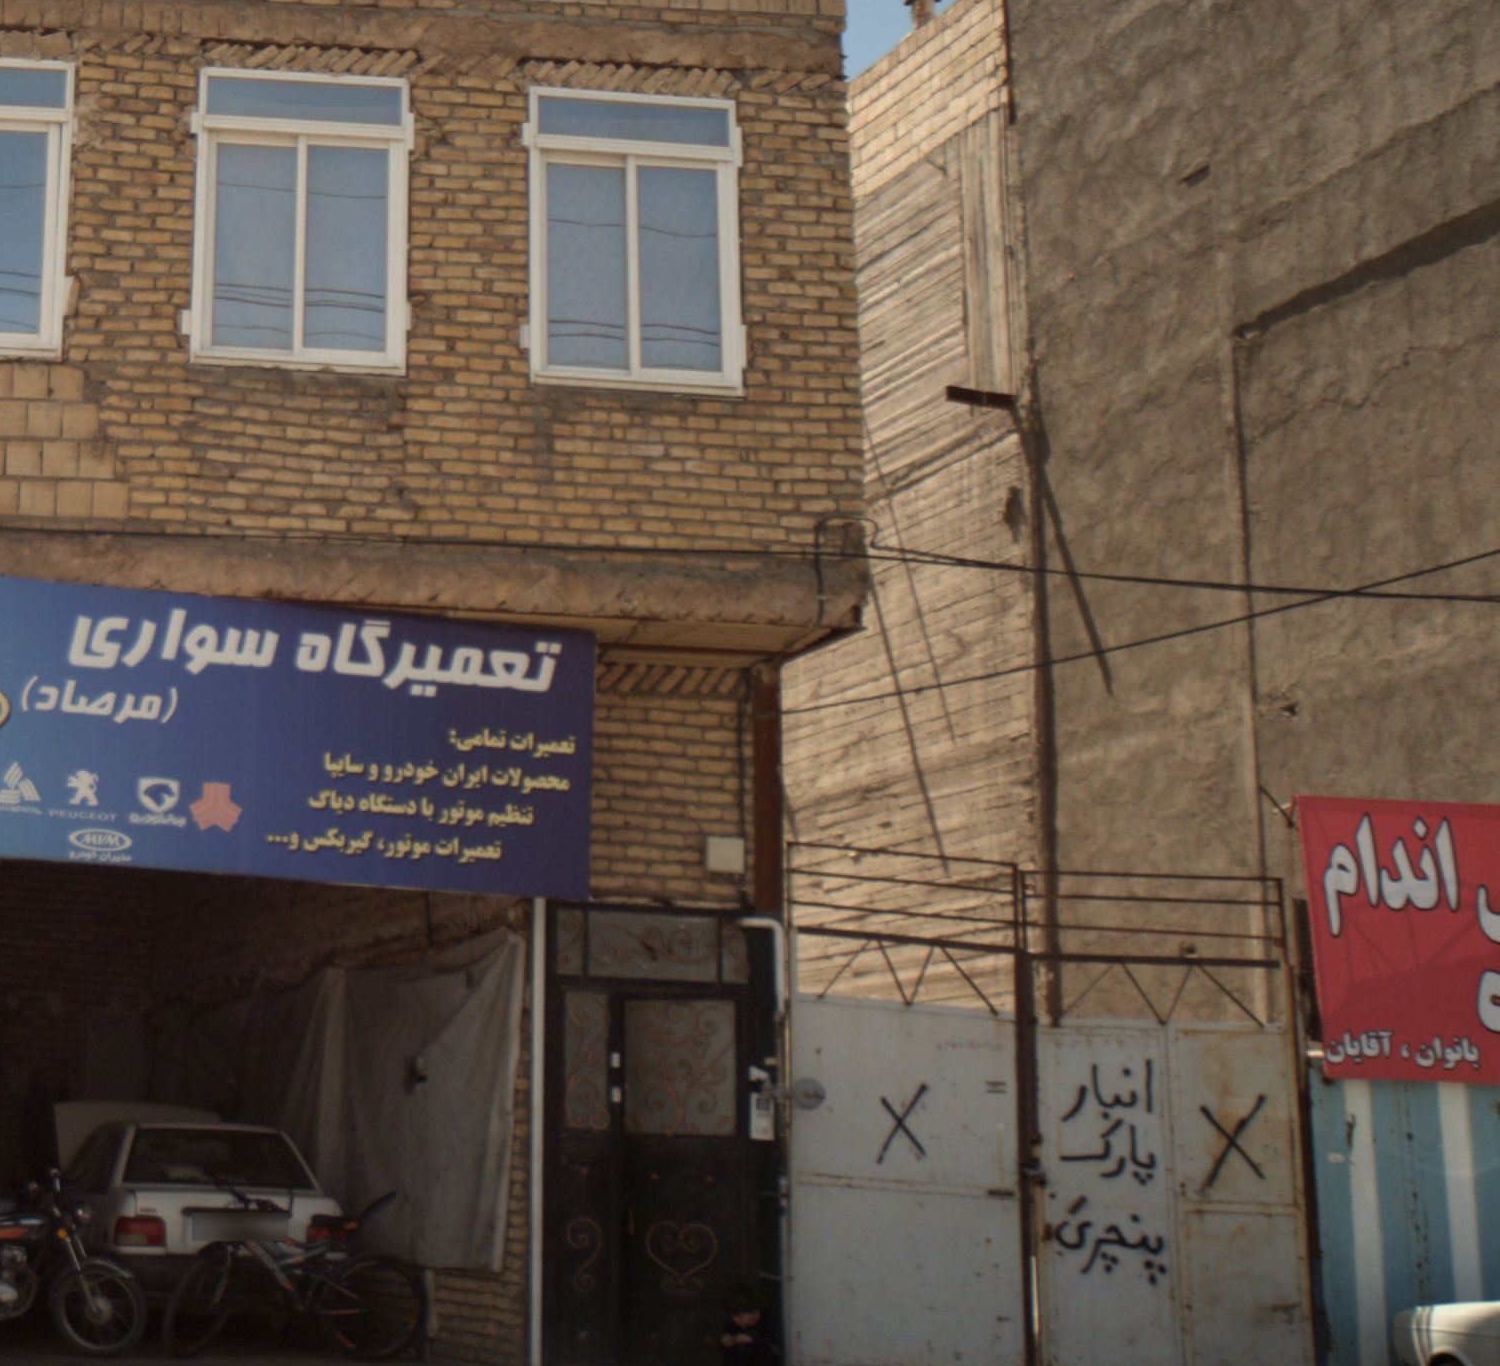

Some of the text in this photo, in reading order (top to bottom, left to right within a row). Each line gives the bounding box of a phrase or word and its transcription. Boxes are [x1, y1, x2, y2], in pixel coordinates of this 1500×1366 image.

[68, 608, 562, 696] تعمیرگاه سواری
[21, 675, 178, 724] (مرصاد)
[449, 728, 576, 758] تعمیرات تمامی:
[324, 751, 570, 794] محصولات ایران خودرو و سایپا
[49, 808, 117, 822] PEUGEOT
[359, 792, 417, 816] دستگاه
[420, 797, 434, 821] با
[438, 802, 484, 825] موتور
[487, 804, 534, 827] تنظیم
[303, 827, 373, 854] گیربکس
[434, 836, 502, 863] تعمیرات
[1323, 813, 1459, 938] اندام
[1324, 1031, 1392, 1063] آقایان
[1062, 1058, 1154, 1122] انبار
[1060, 1119, 1156, 1186] پارک
